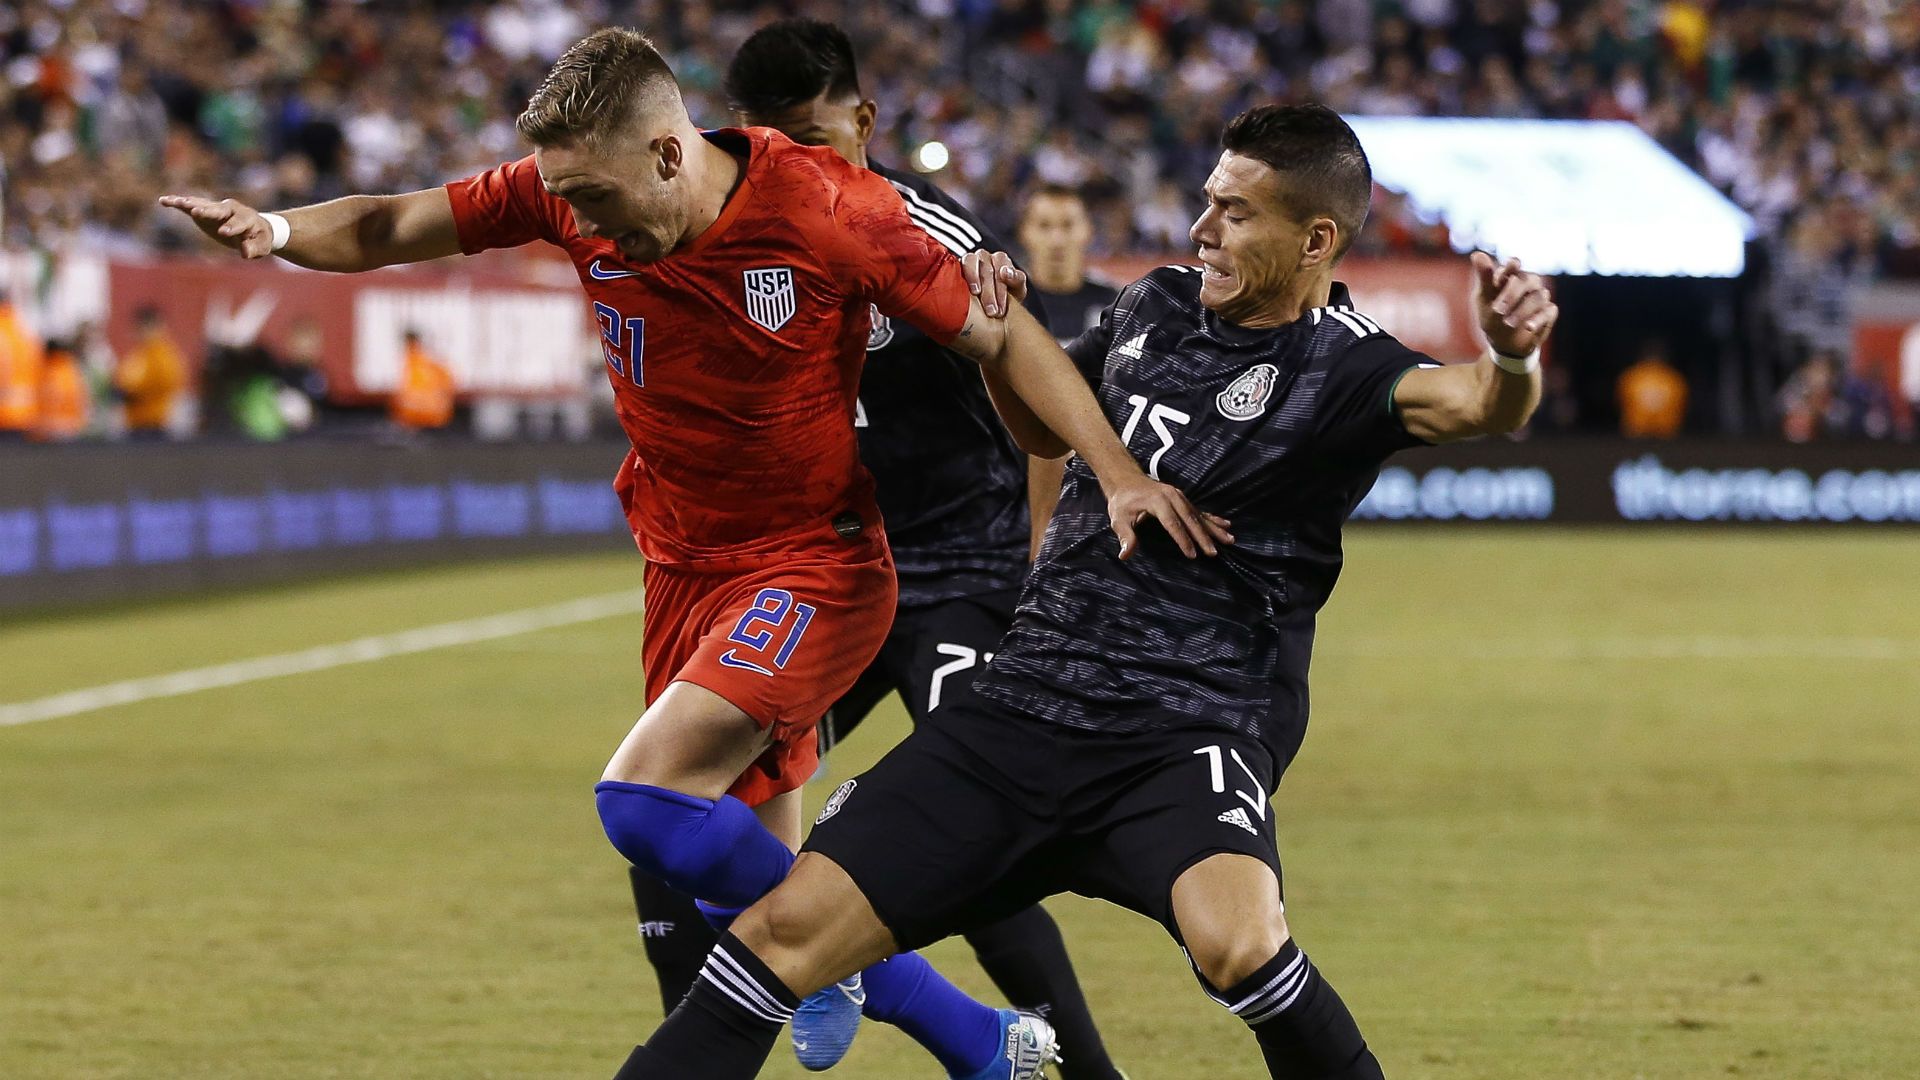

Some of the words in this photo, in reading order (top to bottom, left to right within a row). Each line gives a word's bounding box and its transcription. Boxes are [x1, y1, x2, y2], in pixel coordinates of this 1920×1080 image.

[747, 271, 790, 296] USA
[593, 300, 645, 388] 21
[1128, 394, 1191, 482] 15
[727, 587, 817, 670] 21
[1217, 814, 1258, 836] adidas
